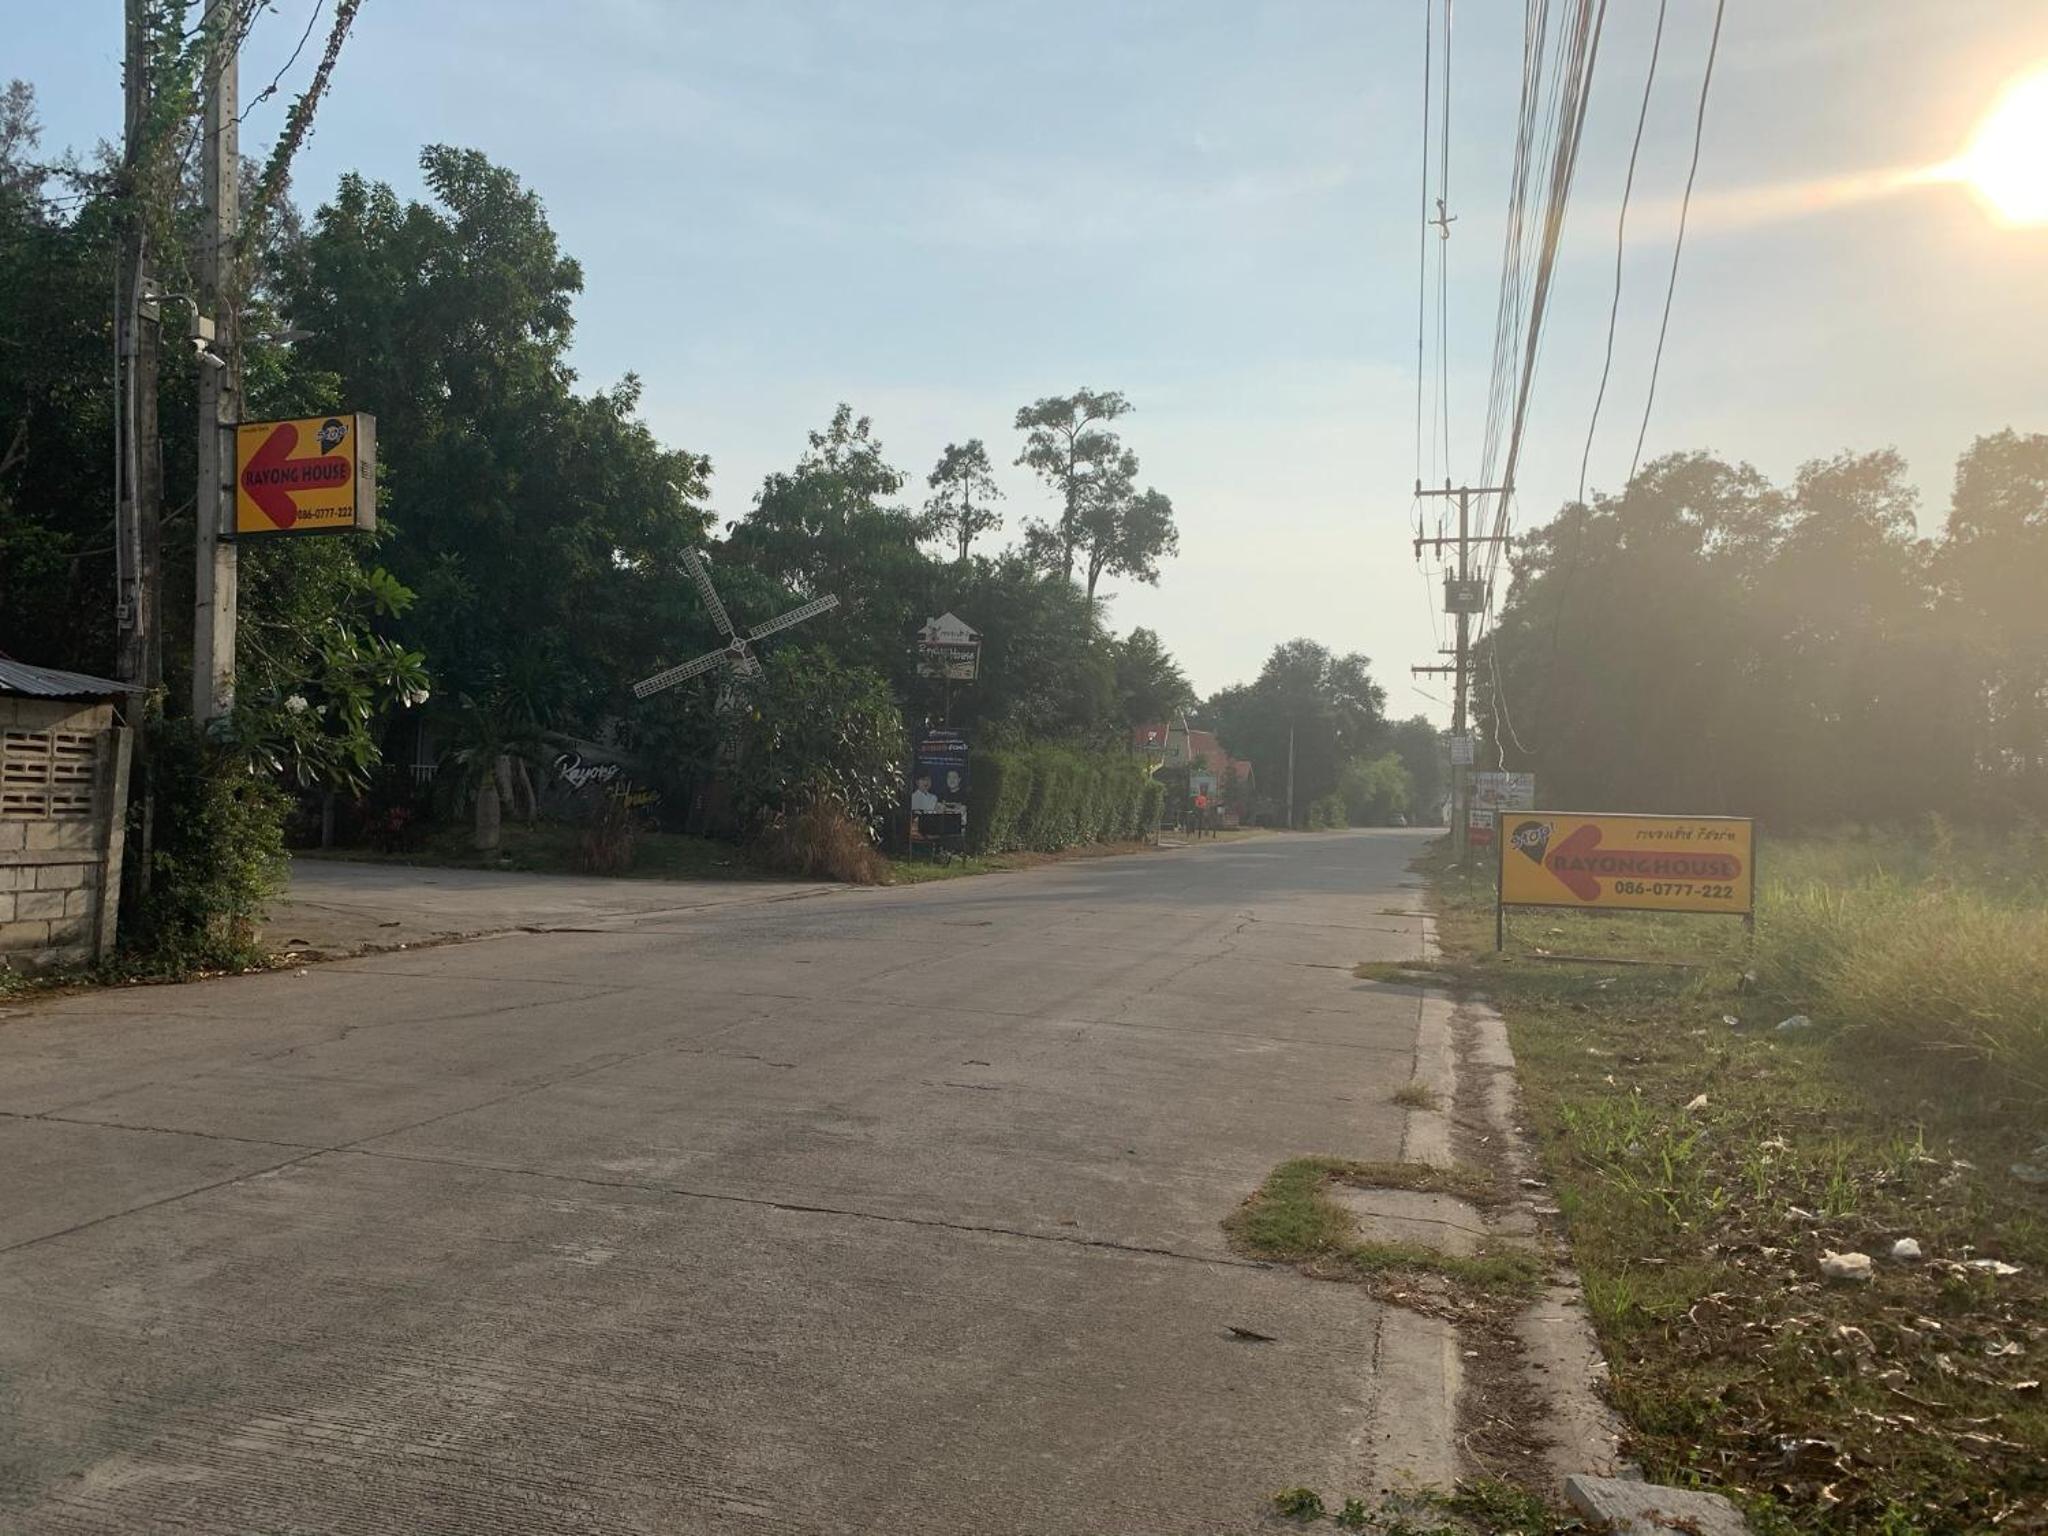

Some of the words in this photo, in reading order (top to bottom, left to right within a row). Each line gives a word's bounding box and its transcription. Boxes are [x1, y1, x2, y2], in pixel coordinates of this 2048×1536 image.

[246, 467, 298, 486] RAYONG
[301, 462, 347, 481] HOUSE
[297, 506, 353, 520] 086-0777-222
[553, 751, 620, 789] Rayong
[1553, 855, 1649, 874] RAYONG
[1652, 858, 1734, 878] HOUSE
[1614, 880, 1734, 899] 086-0777-222
